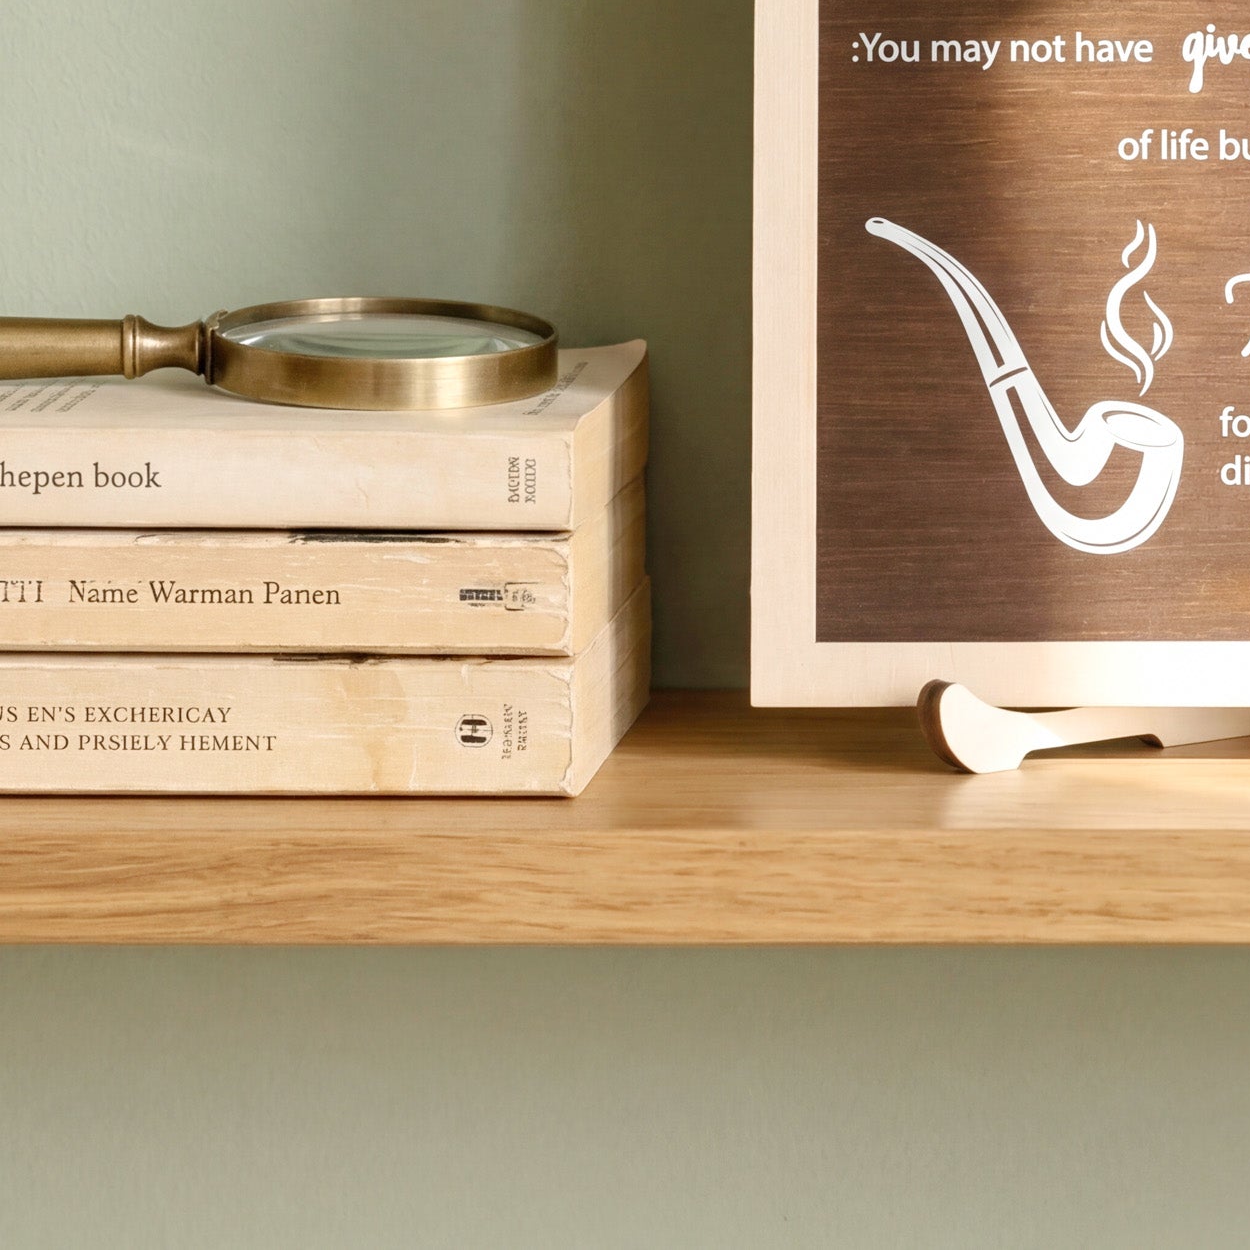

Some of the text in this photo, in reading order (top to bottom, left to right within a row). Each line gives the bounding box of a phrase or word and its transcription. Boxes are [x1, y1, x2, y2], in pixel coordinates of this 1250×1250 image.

[852, 32, 920, 63] :You
[931, 40, 1001, 71] may
[1010, 35, 1066, 63] not
[1075, 31, 1154, 63] have
[1117, 128, 1154, 161] of
[1160, 128, 1210, 161] life
[92, 461, 162, 488] book
[68, 579, 139, 603] Name
[149, 580, 254, 604] Warman
[263, 581, 341, 605] Panen
[27, 706, 75, 723] EN'S
[84, 706, 232, 723] EXCHERICAY
[19, 734, 69, 751] AND
[180, 735, 277, 751] HEMENT
